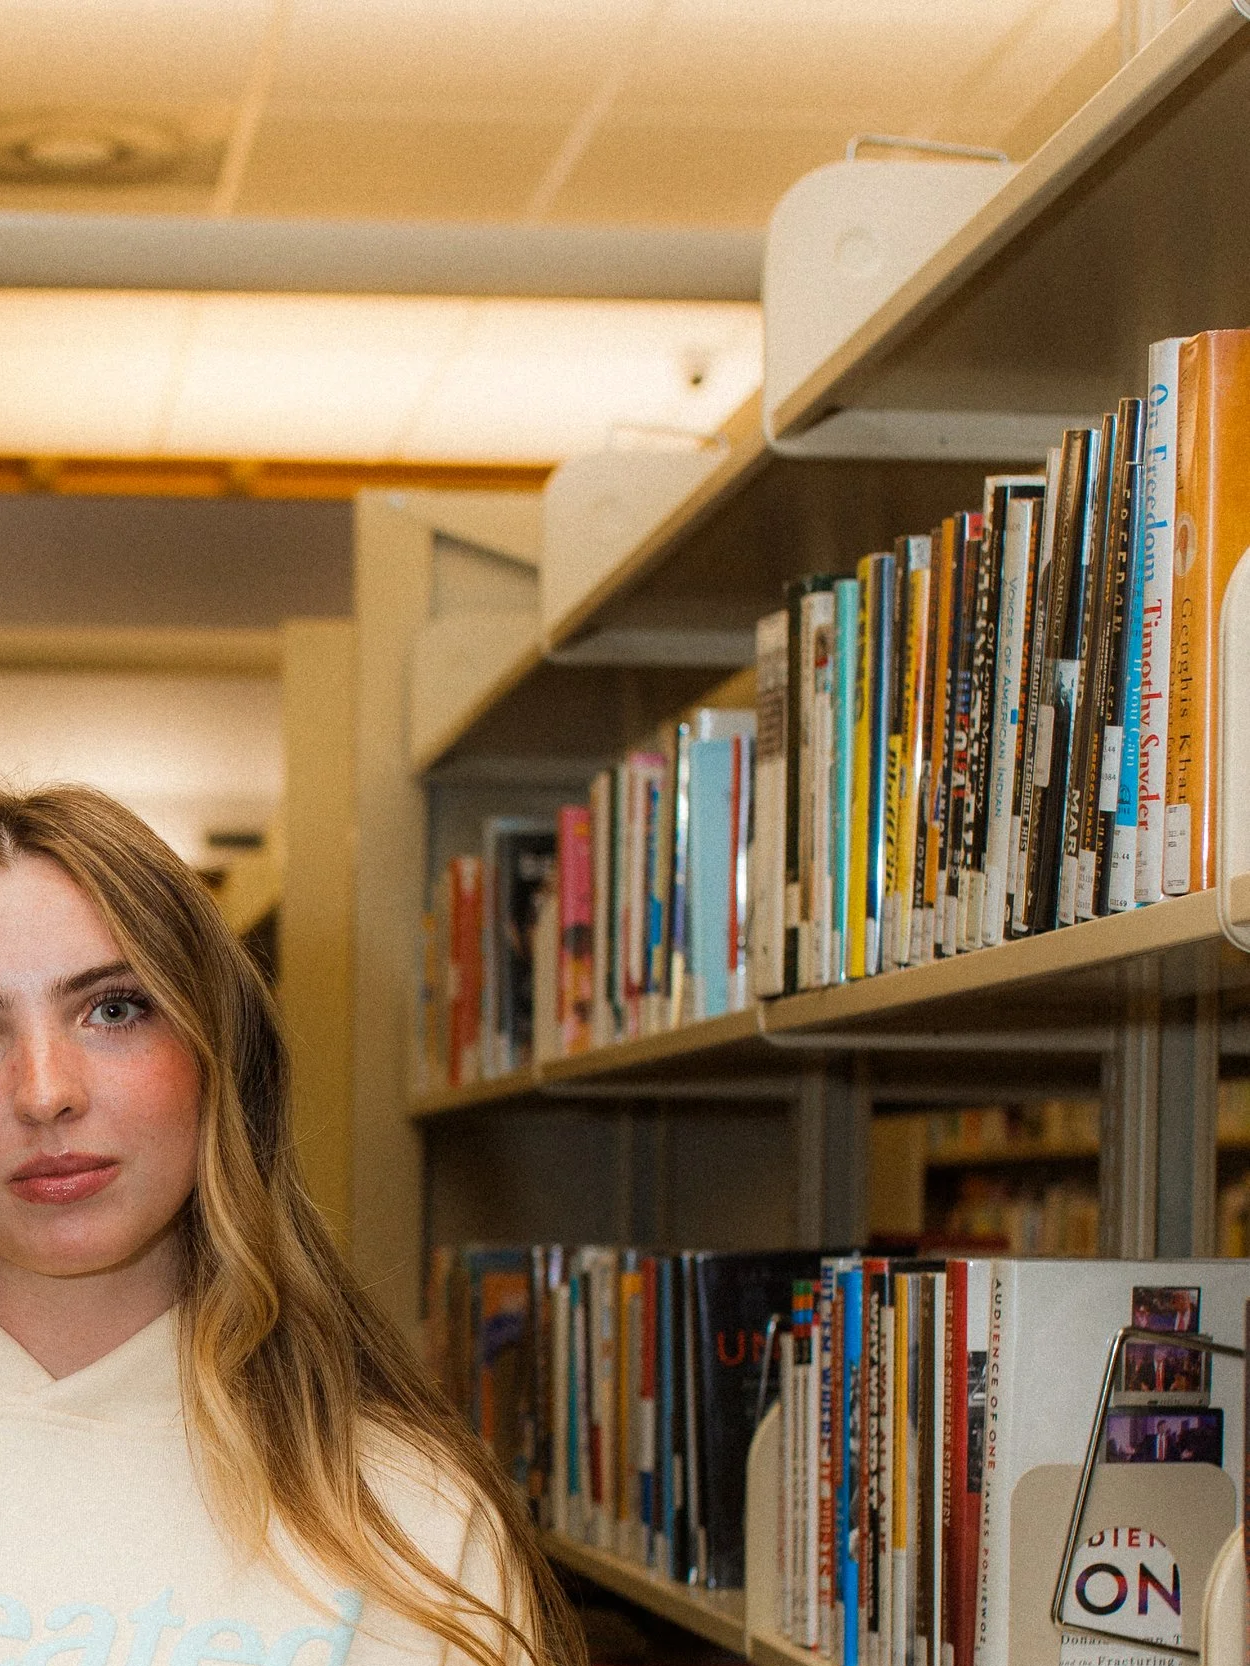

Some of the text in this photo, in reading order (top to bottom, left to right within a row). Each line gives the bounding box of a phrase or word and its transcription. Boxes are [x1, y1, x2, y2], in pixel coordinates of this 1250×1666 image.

[1144, 443, 1168, 583] Freedom
[1036, 609, 1044, 650] MORE
[1053, 556, 1066, 642] CABINET
[1029, 654, 1042, 728] BEAUTIFUL
[1140, 598, 1163, 727] Timothy
[1177, 597, 1194, 718] Genghis
[976, 622, 995, 815] Of Long Memory
[1126, 727, 1140, 767] Can
[1022, 756, 1034, 822] TERRIBLE
[1088, 732, 1099, 802] REBECCA
[988, 1278, 1002, 1470] AUDIENCE OF ONE
[983, 1481, 991, 1537] JAMES
[1075, 1562, 1181, 1616] ON
